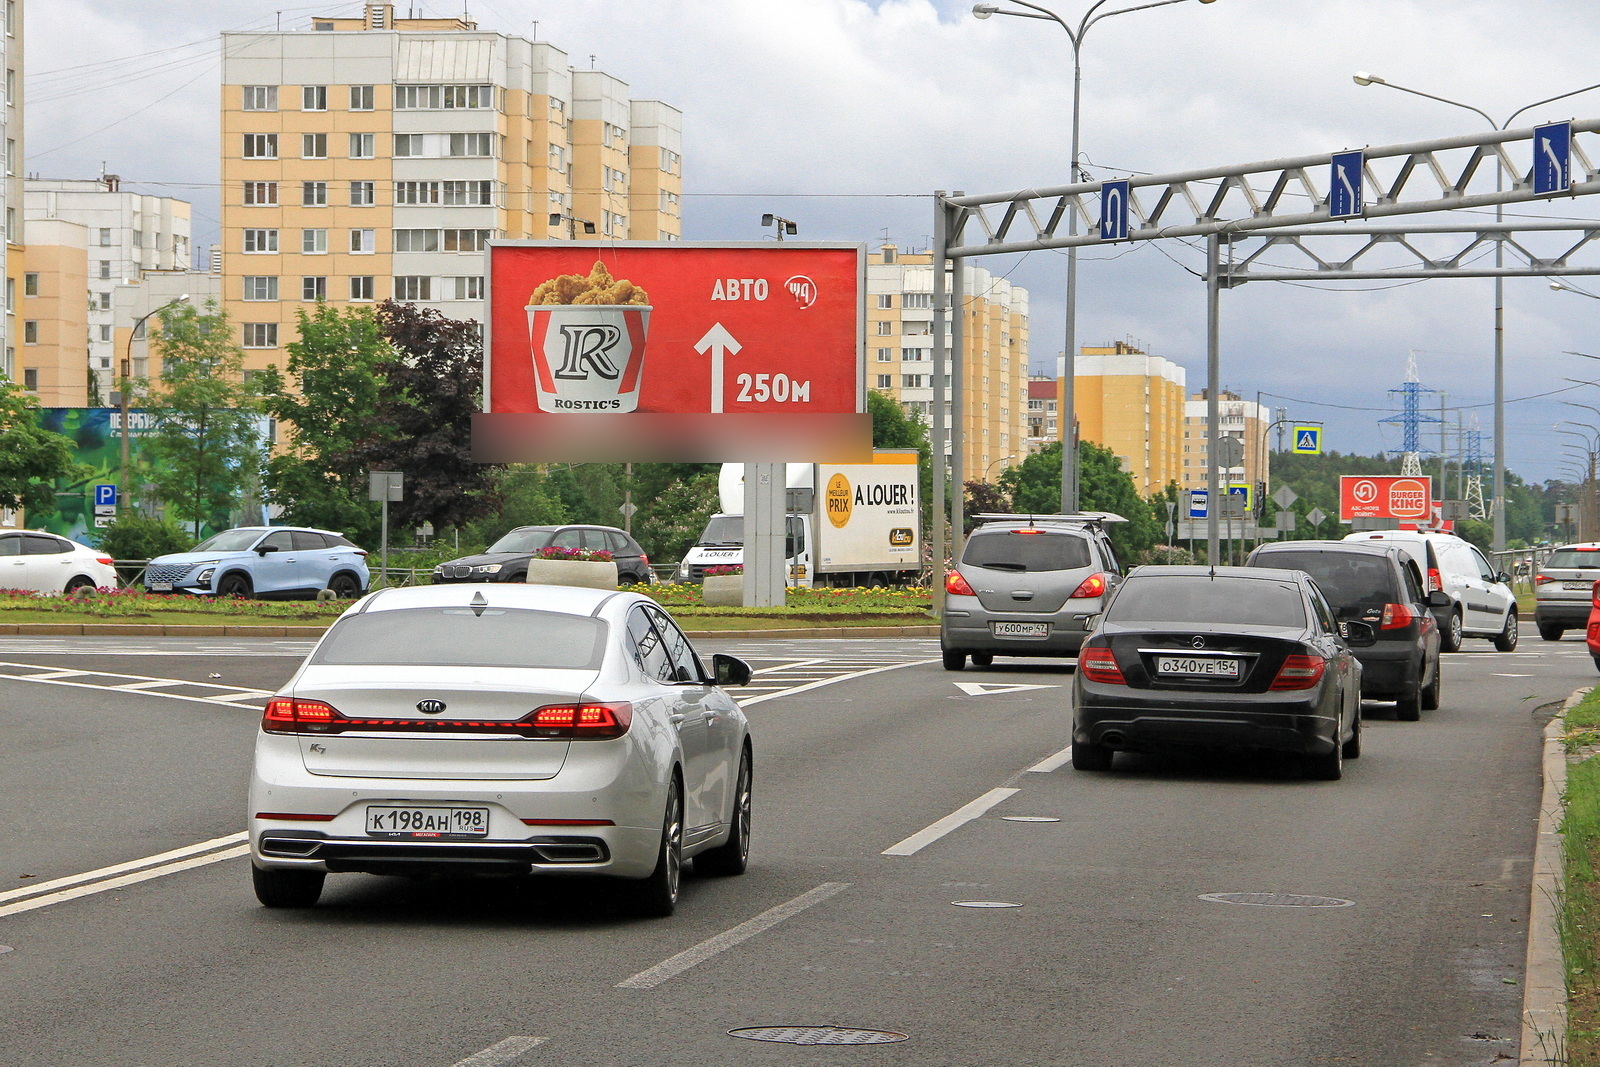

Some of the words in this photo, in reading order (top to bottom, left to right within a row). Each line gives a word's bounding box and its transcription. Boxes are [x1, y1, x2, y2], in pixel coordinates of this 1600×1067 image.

[711, 278, 769, 301] АВТО
[554, 399, 621, 410] ROSTIC'S
[835, 481, 842, 489] LE
[100, 486, 113, 503] P
[829, 489, 849, 497] MEILLEUR
[854, 484, 865, 506] A
[867, 484, 908, 506] LOUER
[1391, 491, 1424, 499] BURGER
[829, 498, 849, 513] PRIX
[1391, 498, 1424, 509] KING
[1035, 624, 1045, 632] 47
[1216, 660, 1236, 671] 154
[420, 702, 442, 712] KIA
[309, 742, 327, 755] K7
[453, 810, 482, 826] 198
